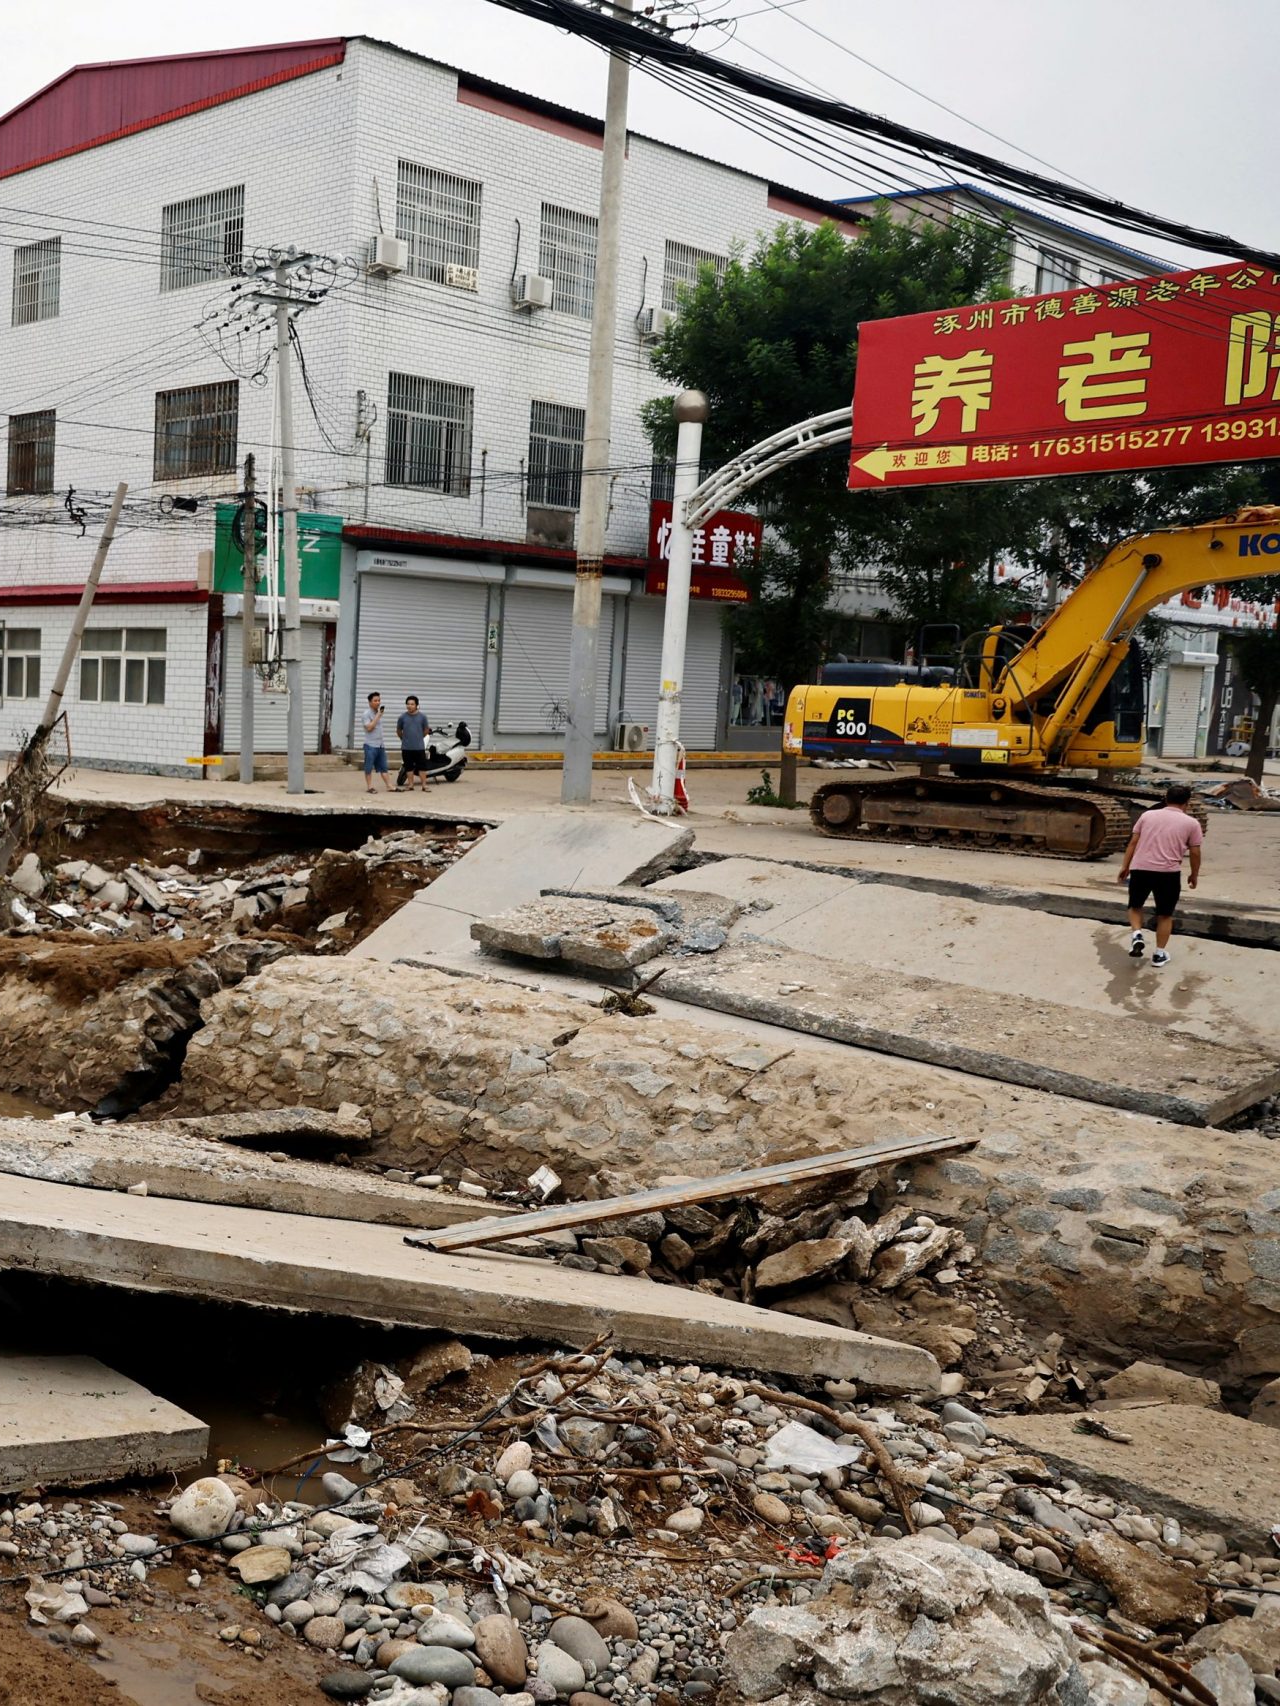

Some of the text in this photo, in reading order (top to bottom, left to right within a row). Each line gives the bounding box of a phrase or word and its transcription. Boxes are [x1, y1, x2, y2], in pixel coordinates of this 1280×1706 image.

[933, 267, 1280, 335] 涿州市德善源老年公
[1028, 426, 1193, 458] 17631515277
[1200, 416, 1280, 443] 13931
[892, 449, 951, 468] 欢迎您
[837, 709, 855, 721] PC
[835, 722, 867, 736] 300
